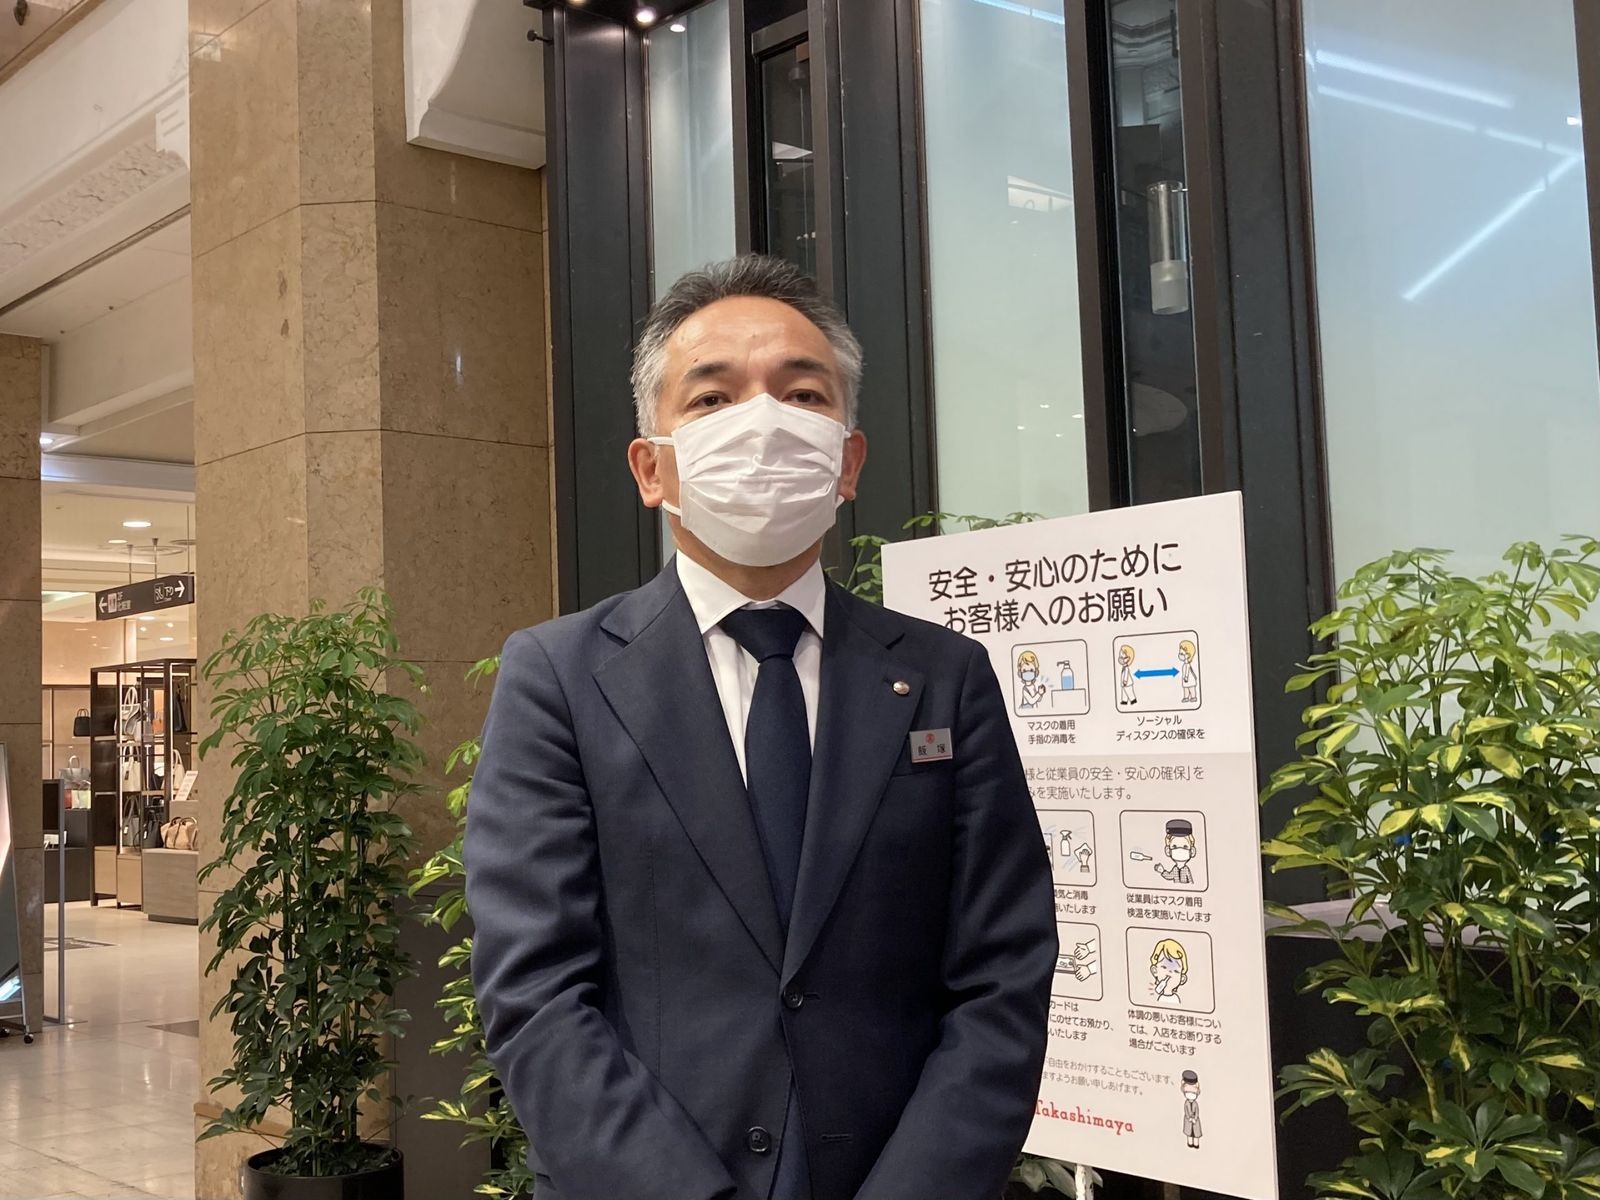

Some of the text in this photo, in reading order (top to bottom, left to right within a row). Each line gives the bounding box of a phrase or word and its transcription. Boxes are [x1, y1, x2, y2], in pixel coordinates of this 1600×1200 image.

[929, 543, 1182, 601] 安全・安心のために
[944, 587, 1168, 634] お客様へのお願い
[1027, 719, 1076, 731] マスクの着用
[1137, 715, 1182, 726] ソーシャル
[1028, 734, 1076, 745] 手指の消毒を
[1116, 728, 1205, 742] ディスタンスの確保を
[1126, 893, 1203, 908] 従業員はマスク着用
[1127, 908, 1212, 923] 検温を実施いたします
[1050, 1013, 1114, 1031] にのせてお預かり、
[1128, 1009, 1222, 1029] 体調の悪いお客様につい
[1048, 1028, 1088, 1041] いたします
[1129, 1023, 1222, 1045] ては、入店をお断りする
[1129, 1038, 1196, 1056] 場合がございます
[1035, 1099, 1134, 1135] Takashimaya
